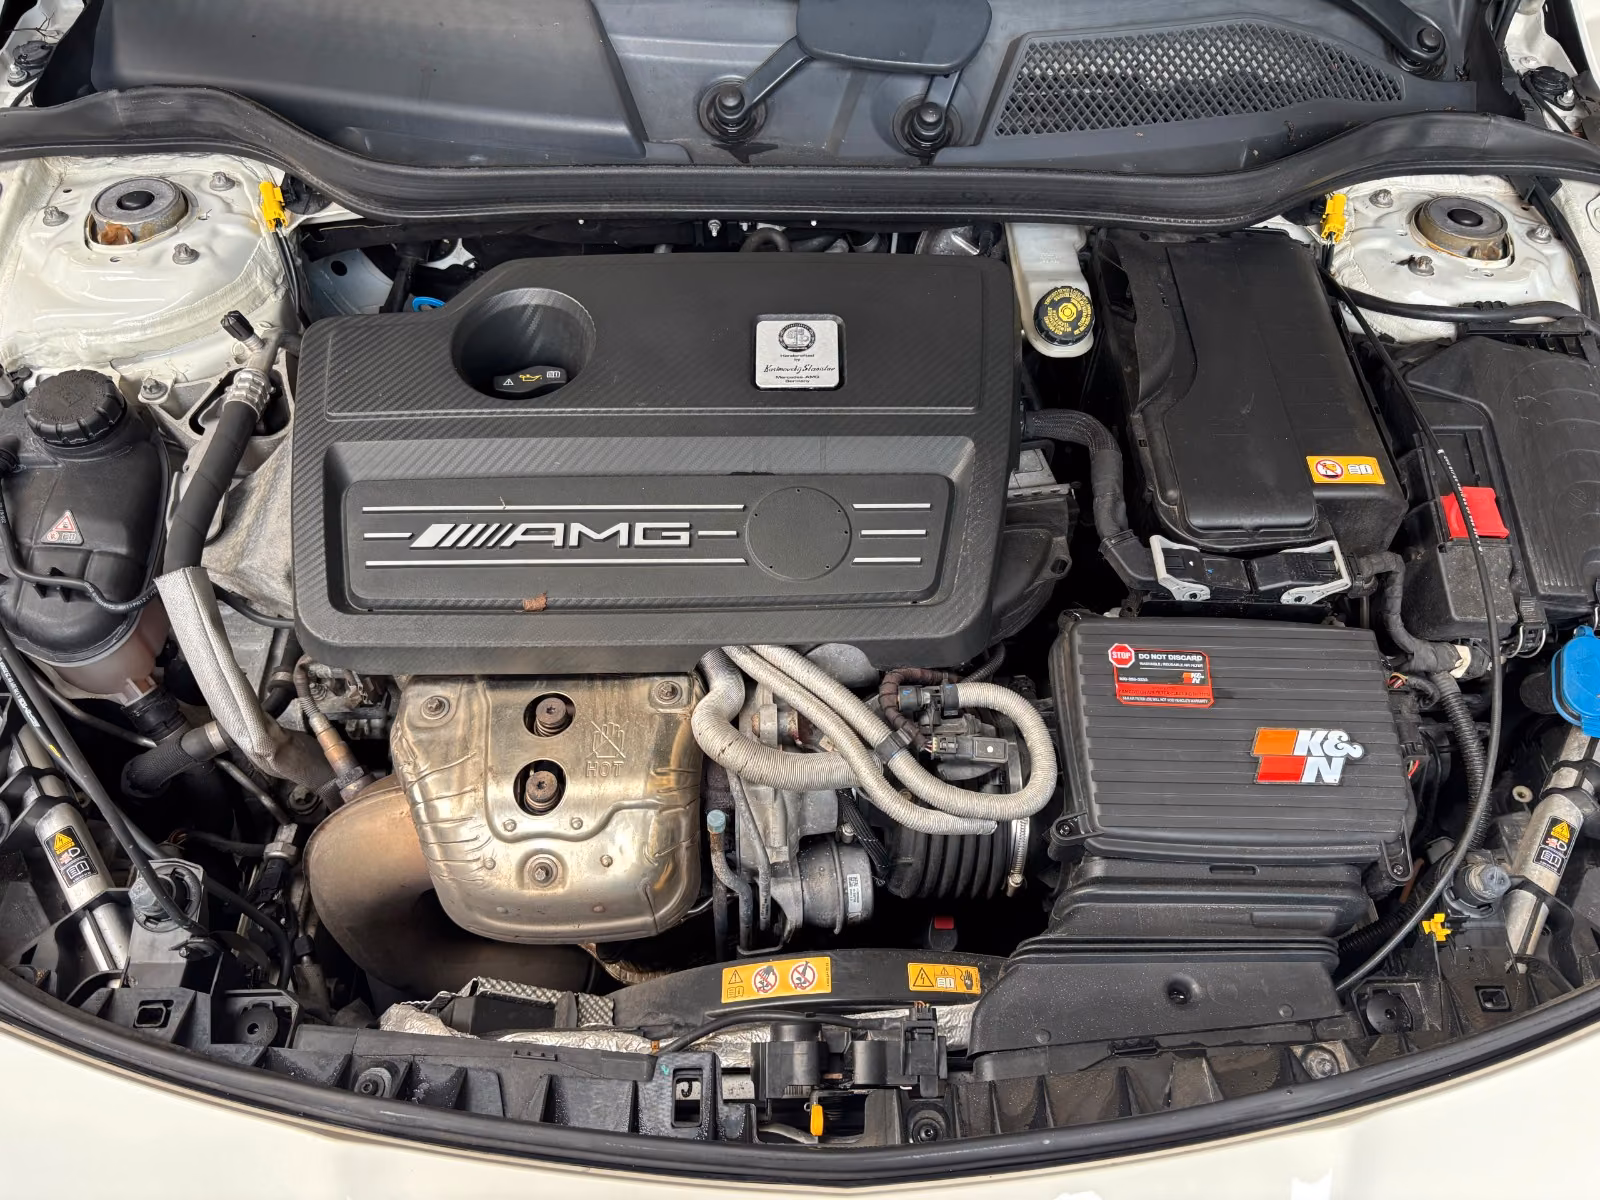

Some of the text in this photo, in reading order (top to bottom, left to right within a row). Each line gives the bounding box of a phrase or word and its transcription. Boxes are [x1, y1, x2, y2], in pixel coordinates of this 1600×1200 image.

[500, 522, 691, 548] AMG
[1112, 651, 1131, 659] STOP
[586, 761, 625, 778] HOT
